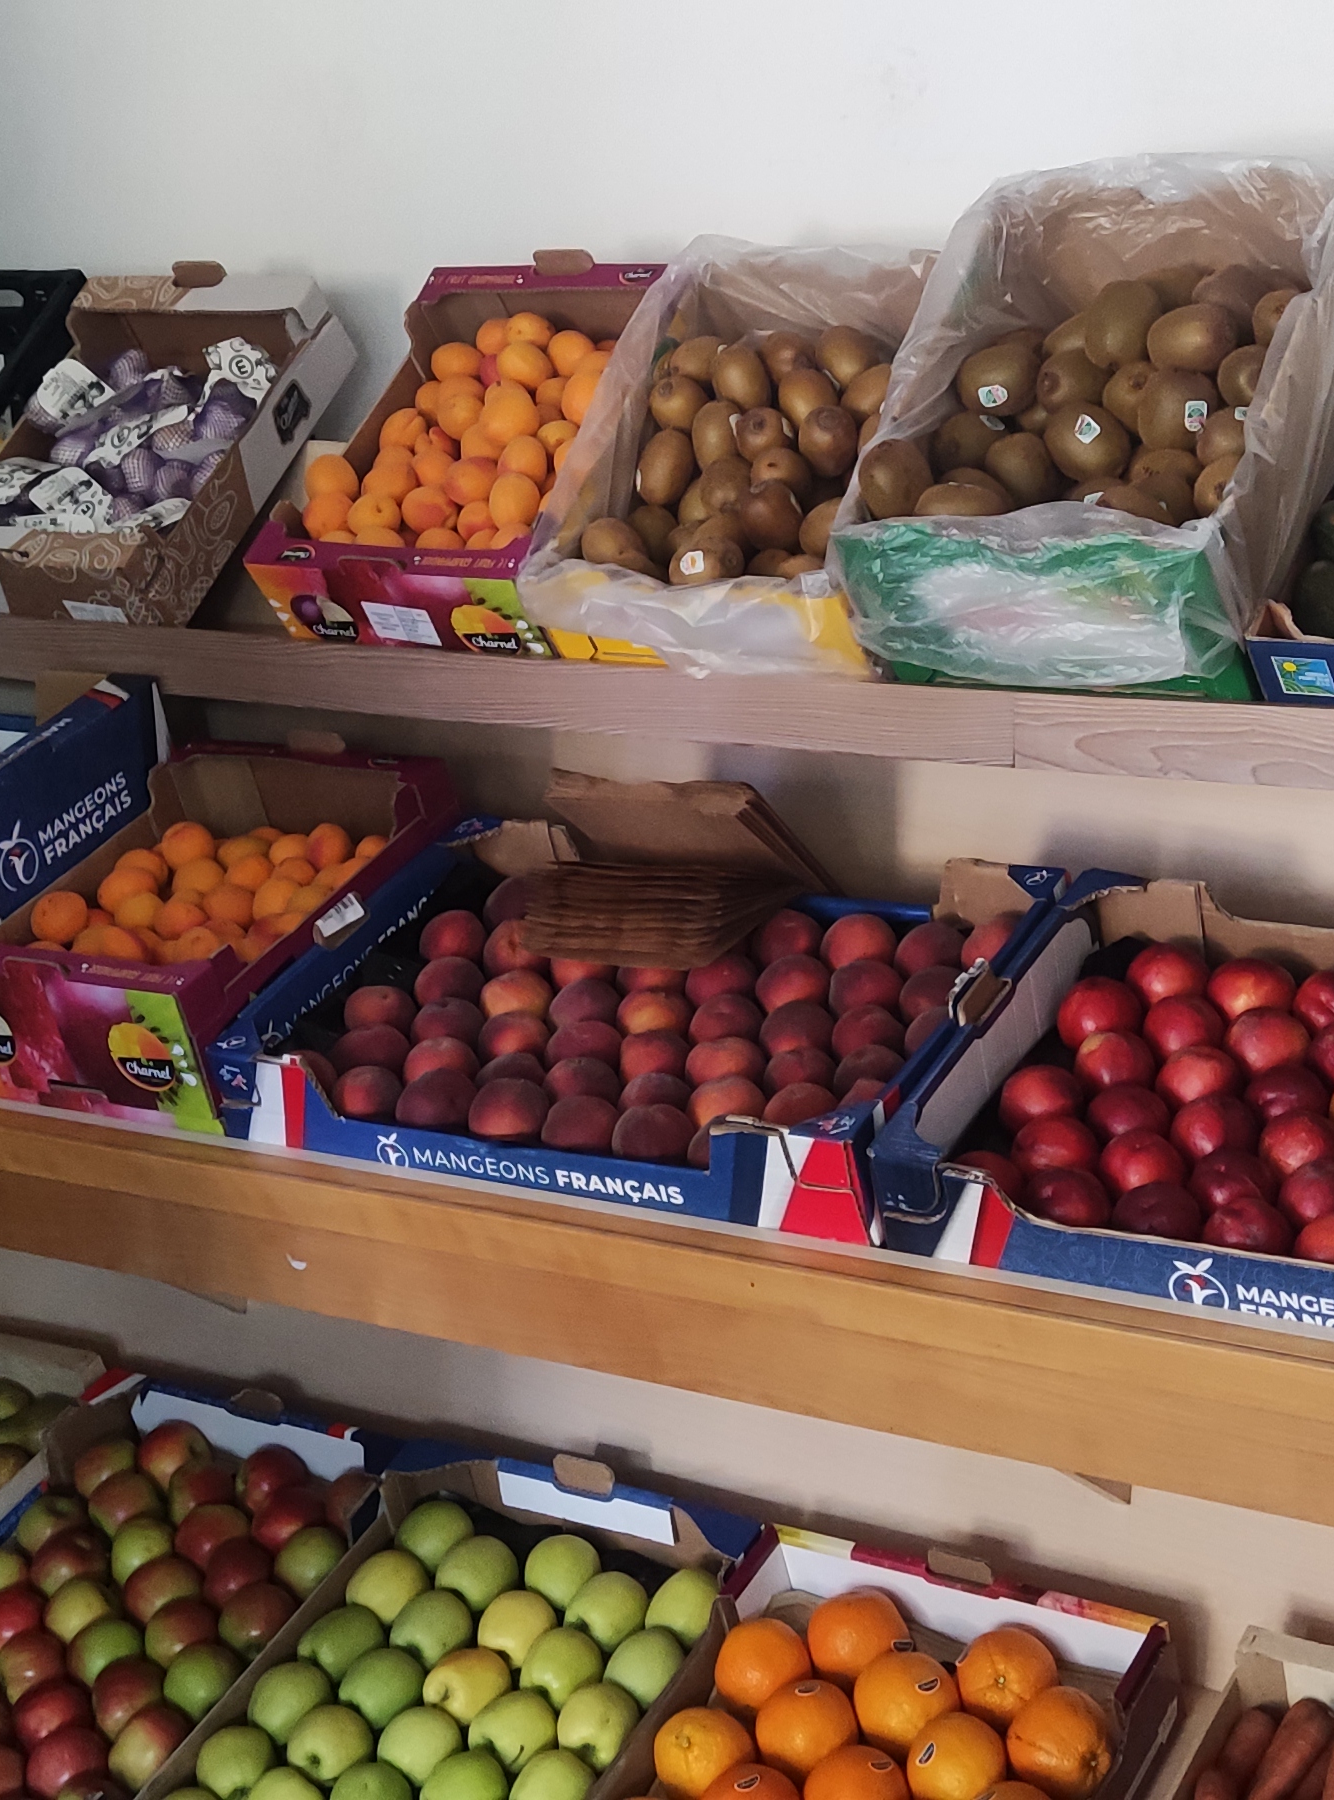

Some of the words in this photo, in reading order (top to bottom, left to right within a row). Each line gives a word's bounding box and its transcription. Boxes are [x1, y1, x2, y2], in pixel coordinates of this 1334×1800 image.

[471, 635, 519, 650] Charnel
[36, 770, 127, 847] MANGEONS
[42, 789, 133, 867] FRANÇAIS
[125, 1060, 173, 1081] Charnel
[412, 1146, 550, 1185] MANGEONS
[553, 1169, 685, 1205] FRANÇAIS
